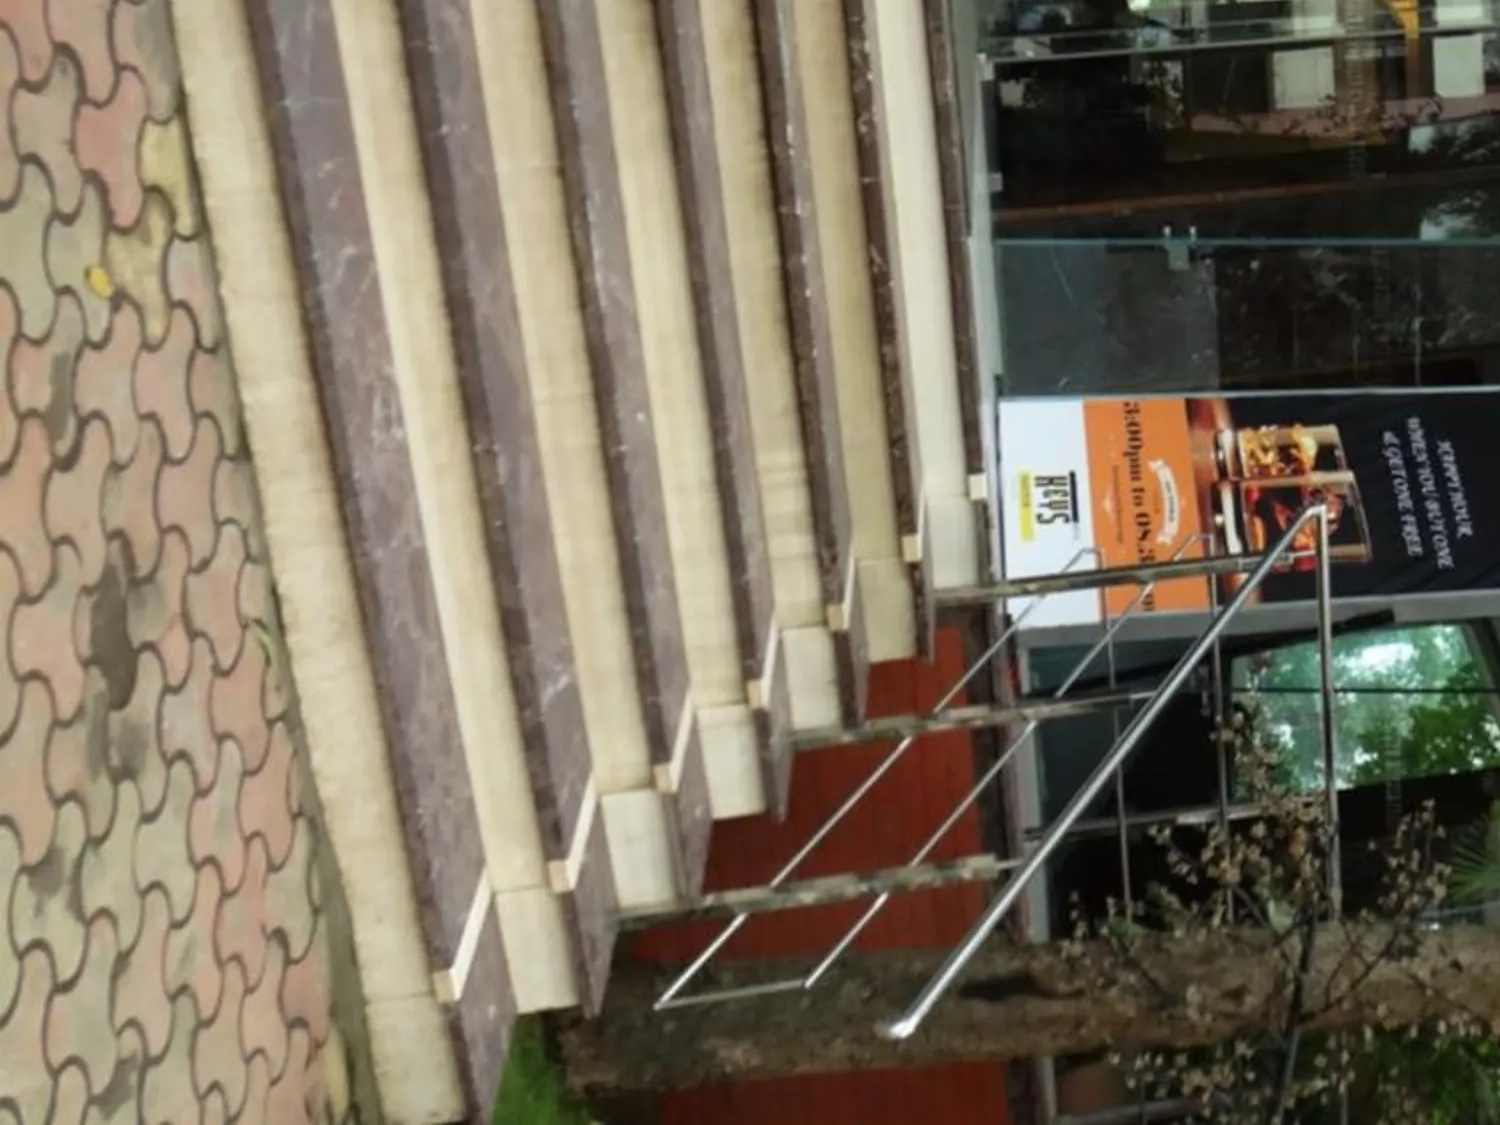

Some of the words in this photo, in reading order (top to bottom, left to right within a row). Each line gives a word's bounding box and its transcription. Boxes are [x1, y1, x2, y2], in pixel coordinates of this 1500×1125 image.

[1132, 487, 1148, 508] to
[1448, 490, 1472, 538] HOUR
[1400, 513, 1423, 557] FREE
[1431, 534, 1455, 570] ONE
